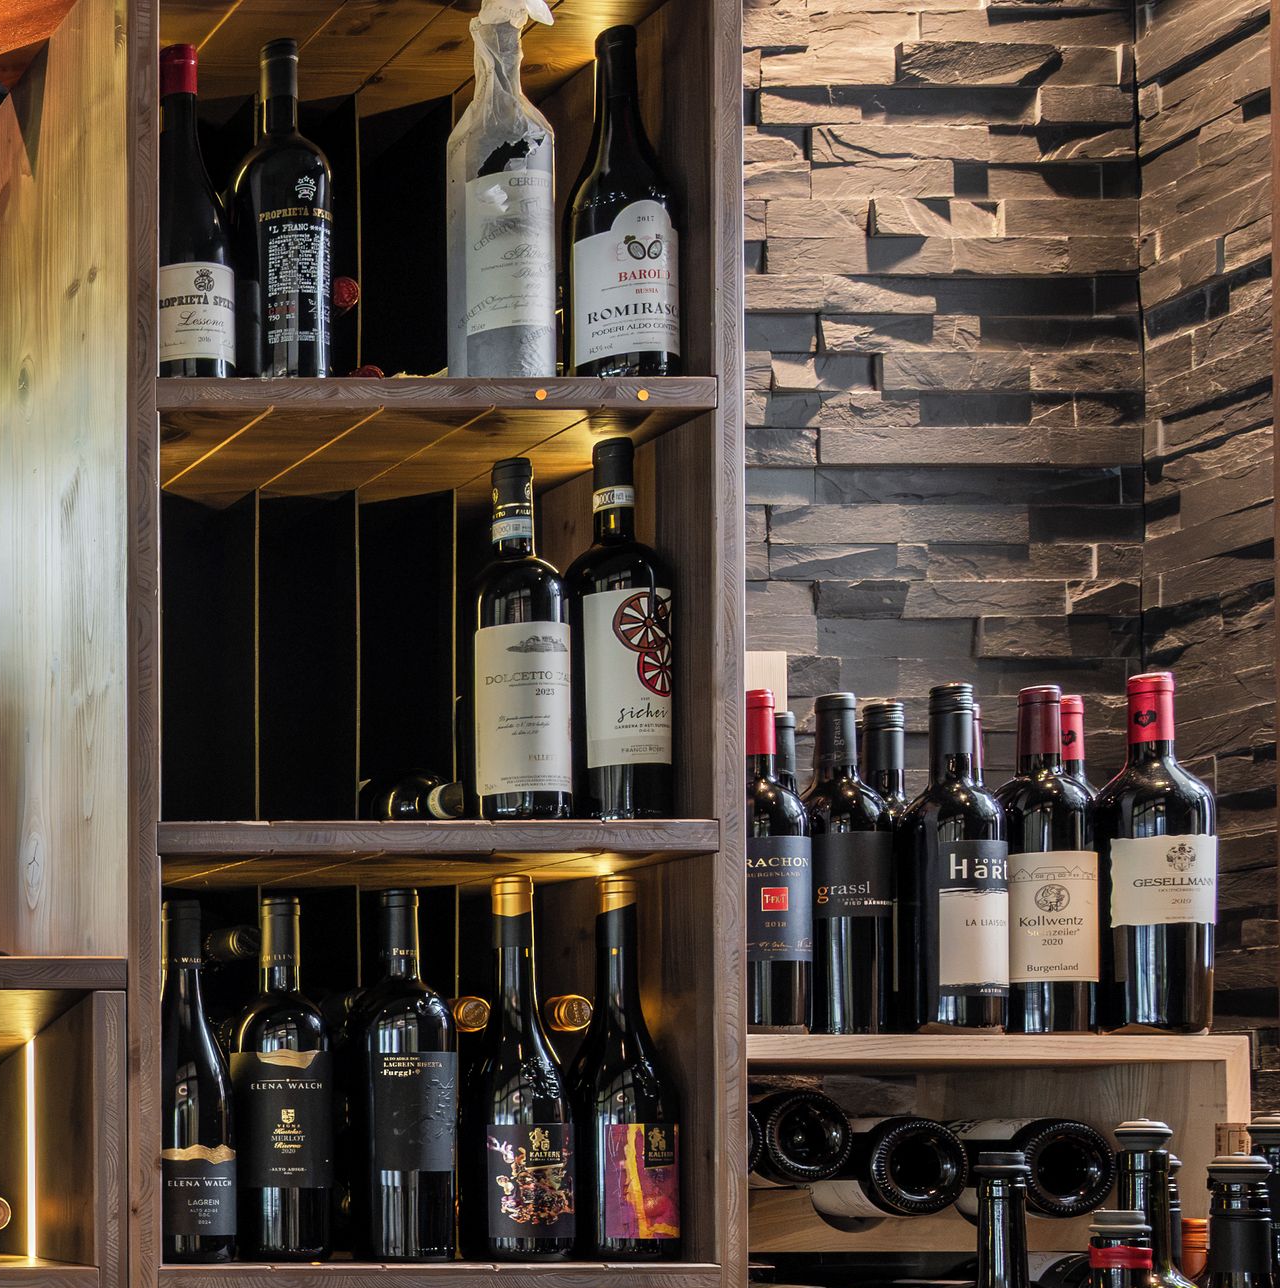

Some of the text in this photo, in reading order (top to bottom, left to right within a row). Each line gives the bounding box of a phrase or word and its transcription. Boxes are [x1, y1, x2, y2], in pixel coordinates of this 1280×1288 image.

[258, 206, 309, 222] PROPRIETÀ
[282, 223, 308, 232] FRANC
[178, 310, 225, 326] Lessona
[592, 322, 651, 338] PODERI ALDO
[485, 670, 553, 685] DOLCETTO
[535, 688, 555, 696] 2023
[817, 881, 870, 904] grassl
[1019, 916, 1084, 928] Kollwentz
[1042, 938, 1064, 946] 2020
[1026, 962, 1079, 974] Burgenland
[250, 1082, 323, 1090] ELENA WALCH
[271, 1134, 306, 1142] MERLOT
[168, 1178, 232, 1188] ELENA WALCH
[188, 1198, 220, 1206] LAGREIN
